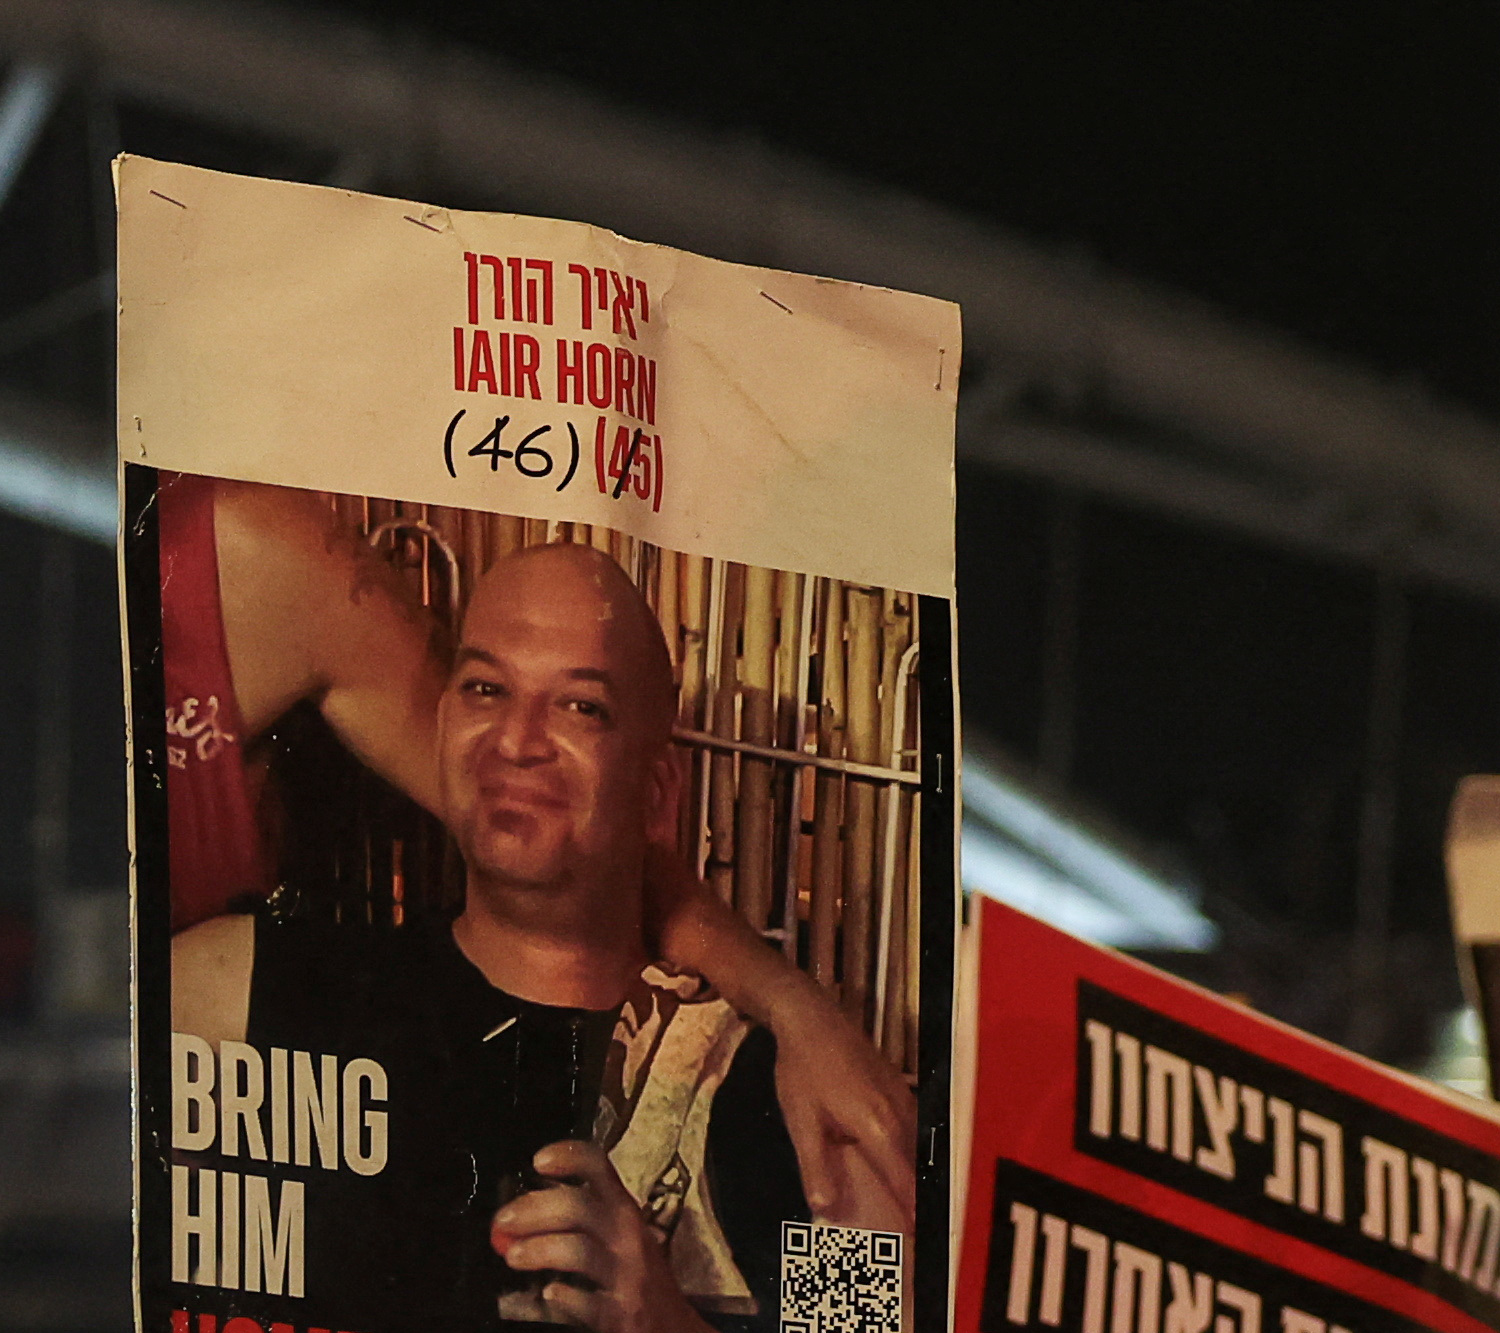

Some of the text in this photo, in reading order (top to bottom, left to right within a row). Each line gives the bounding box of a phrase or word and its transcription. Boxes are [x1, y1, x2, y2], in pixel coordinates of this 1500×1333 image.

[463, 250, 650, 341] יאיר הורן
[452, 326, 657, 427] IAIR HORN
[443, 407, 581, 492] (46)
[169, 1032, 391, 1177] BRING
[1085, 1019, 1345, 1224] הניצחון
[169, 1163, 307, 1300] HIM
